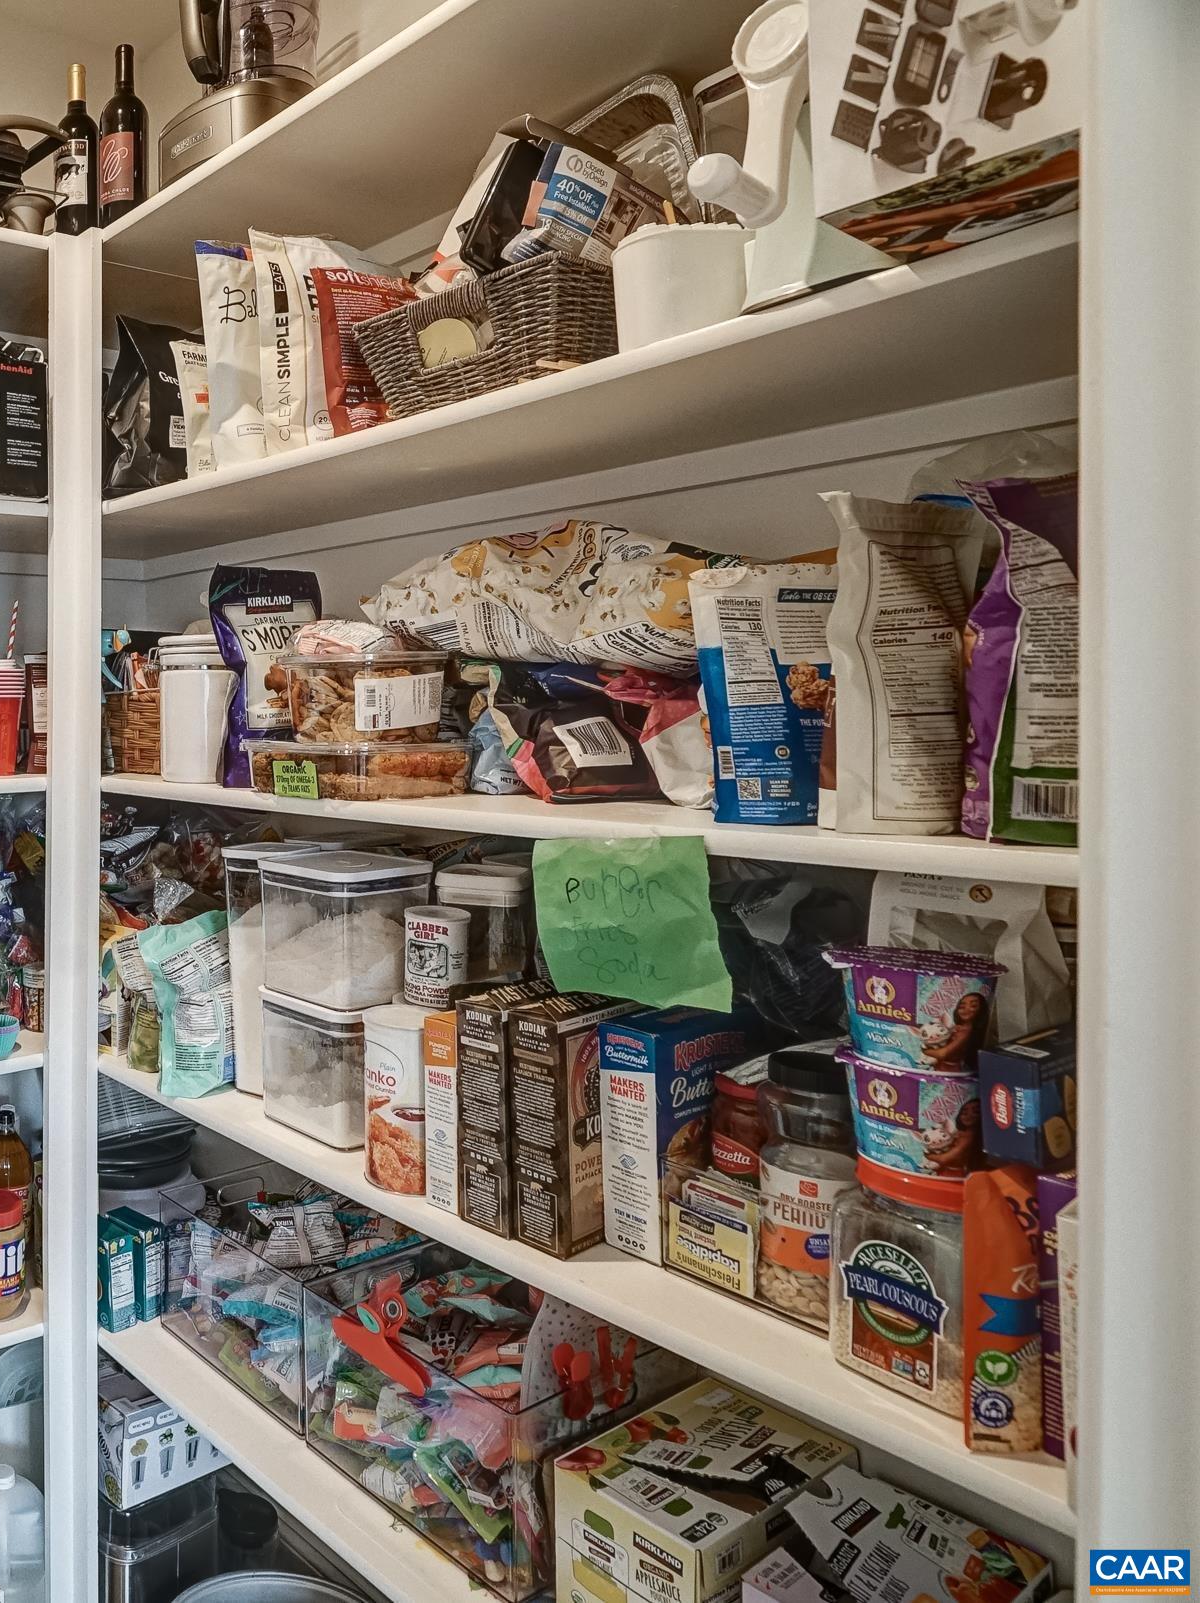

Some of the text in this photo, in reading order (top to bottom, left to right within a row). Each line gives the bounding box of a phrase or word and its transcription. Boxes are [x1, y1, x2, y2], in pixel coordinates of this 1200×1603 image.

[585, 160, 605, 177] Closets
[553, 190, 596, 216] Free Installation
[273, 262, 284, 293] EATS
[276, 316, 291, 379] SIMPLE
[279, 381, 291, 442] CLEAN
[247, 595, 292, 608] KIRKLAND
[716, 599, 761, 607] Nutrition Facts
[254, 615, 288, 625] CARAMEL
[879, 607, 925, 616] Nutrition
[641, 622, 694, 649] Nutrition
[748, 622, 762, 631] 130
[607, 634, 645, 657] Calories
[872, 632, 953, 645] Calories 140
[566, 866, 662, 918] Burger
[408, 921, 449, 936] CLABBER
[414, 931, 437, 941] GIRL
[577, 946, 670, 984] Soda
[492, 982, 529, 1004] TASTE
[546, 995, 580, 1014] TASTE
[858, 1000, 913, 1022] Annie's
[465, 1010, 492, 1025] KODIAK
[463, 1025, 484, 1034] FLAPJACK
[465, 1030, 482, 1038] WAFFLE
[519, 1020, 547, 1037] KODIAK
[516, 1036, 538, 1046] FLAPJACK
[519, 1042, 537, 1050] WAFFLE
[460, 1055, 500, 1070] FLAPJACK TRADITION
[604, 1044, 649, 1066] Buttermilk
[380, 1062, 396, 1073] Plain
[428, 1069, 452, 1083] MAKERS
[366, 1068, 397, 1087] anko
[428, 1077, 452, 1090] WANTED
[610, 1074, 644, 1092] MAKERS
[610, 1084, 646, 1102] WANTED
[860, 1100, 914, 1126] Annie's
[995, 1088, 1009, 1124] Barilla
[797, 1198, 832, 1212] ROASTE
[614, 1207, 627, 1217] STAY
[633, 1214, 648, 1225] TOUCH
[676, 1235, 740, 1274] RapidRise
[676, 1252, 741, 1290] Fleischmann's
[859, 1243, 928, 1288] RICESELECT
[850, 1272, 937, 1322] PEARL COUSCOUS
[836, 1500, 871, 1530] KIRKLAND
[584, 1531, 615, 1554] KIRKLAND
[635, 1535, 682, 1569] KIRKLAND
[832, 1543, 858, 1575] RGANIC
[642, 1563, 670, 1580] ORGANIC
[636, 1569, 681, 1602] APPLESAUCE
